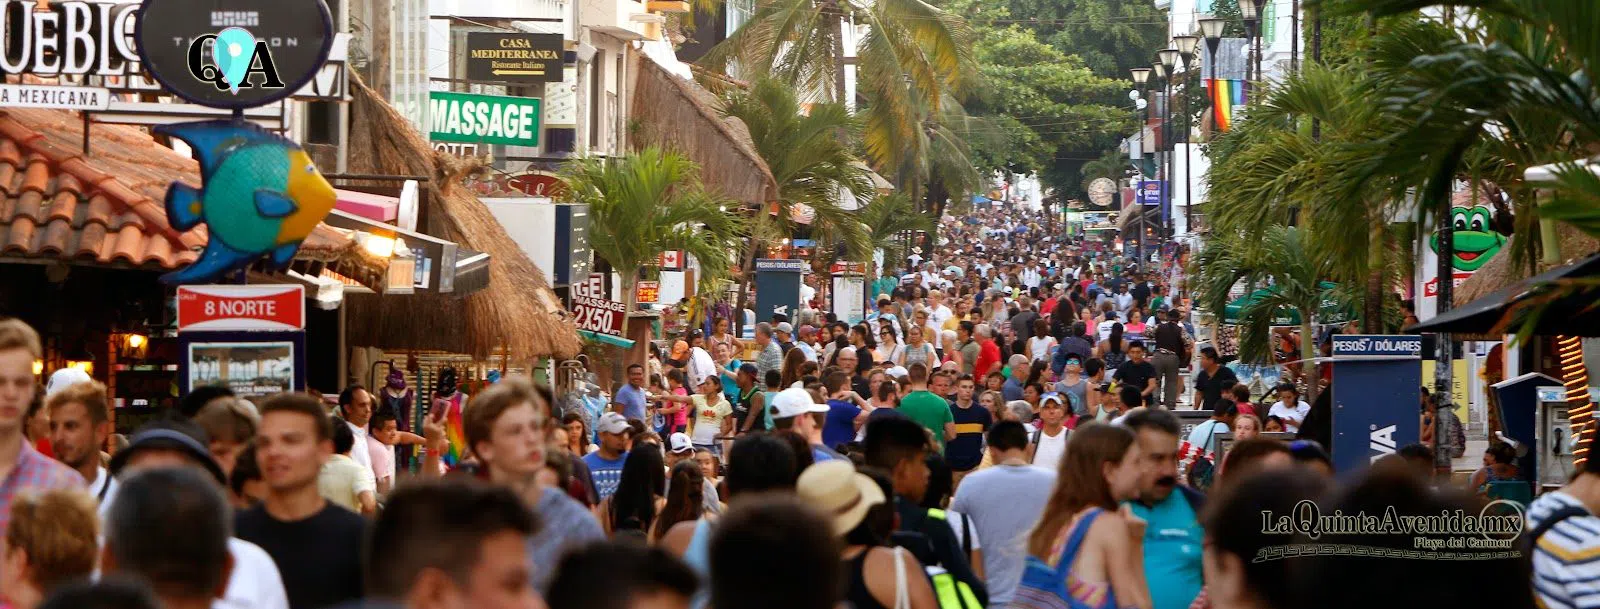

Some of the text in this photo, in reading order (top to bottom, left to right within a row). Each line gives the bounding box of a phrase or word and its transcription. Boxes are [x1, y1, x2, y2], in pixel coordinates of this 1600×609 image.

[500, 38, 531, 48] CASA
[471, 49, 559, 59] MEDITERRANEA
[491, 60, 545, 69] Ristorante Italiano
[19, 89, 99, 106] MEXICANA
[430, 99, 533, 139] MASSAGE
[204, 300, 276, 316] 8 NORTE
[576, 295, 627, 313] MASSAGE
[574, 304, 614, 333] 2X50
[1333, 340, 1367, 351] PESOS
[1375, 339, 1421, 351] DÓLARES
